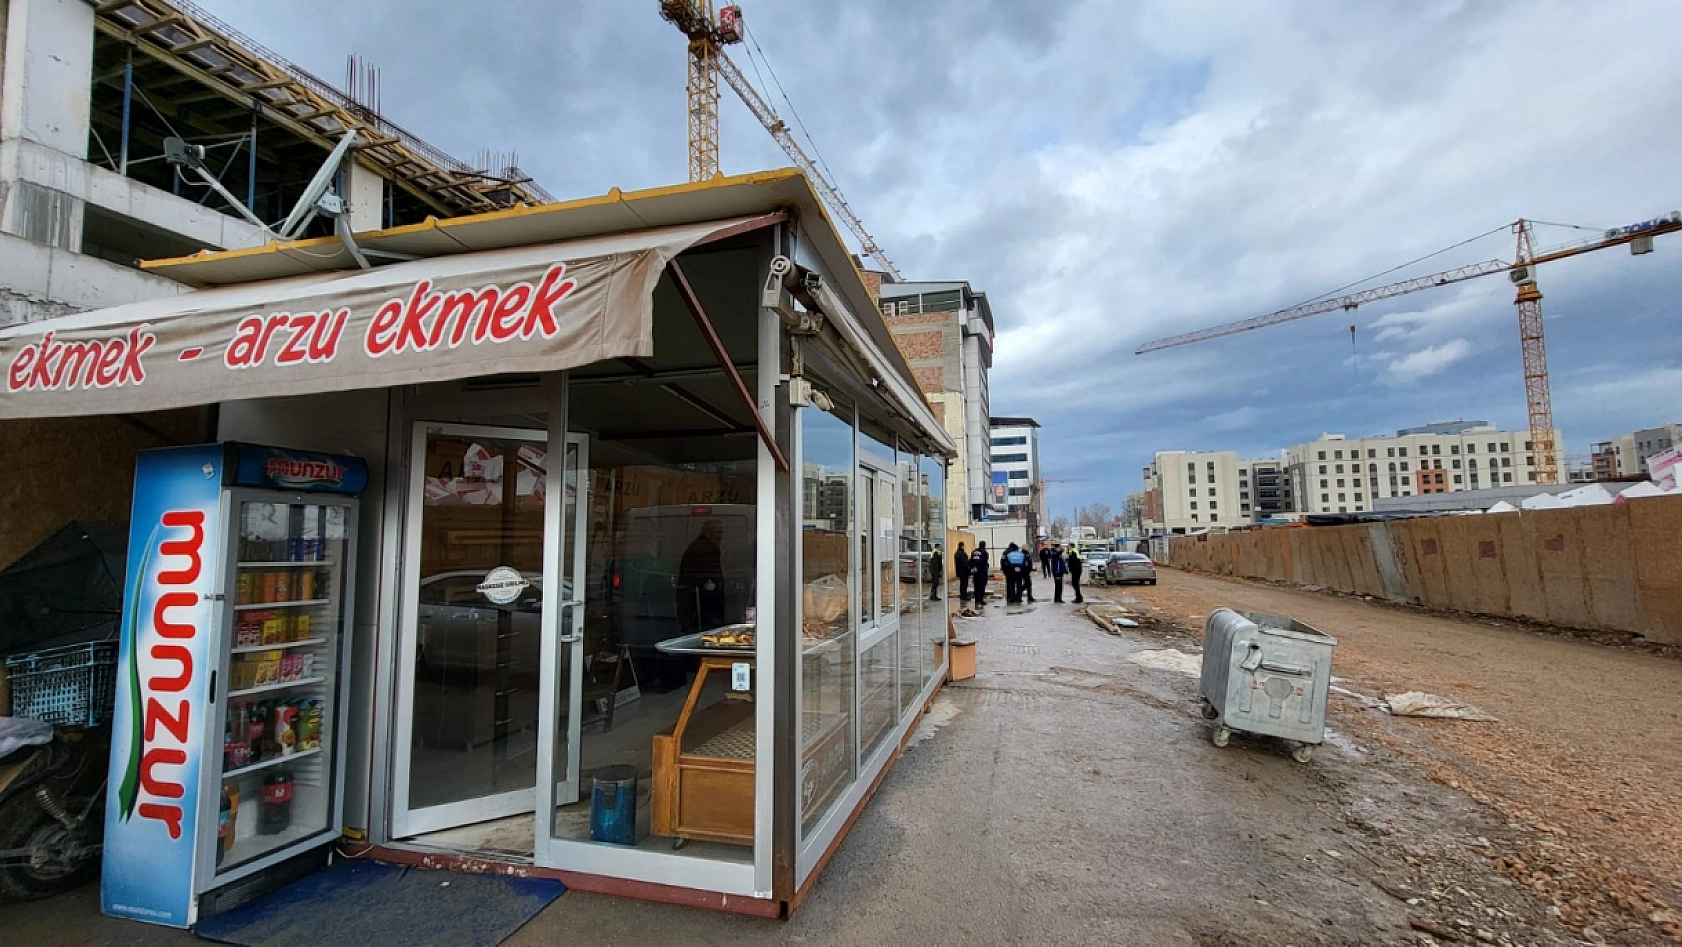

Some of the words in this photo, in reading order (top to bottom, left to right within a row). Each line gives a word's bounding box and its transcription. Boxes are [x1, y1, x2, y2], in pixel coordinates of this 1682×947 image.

[9, 331, 154, 391] ekmek
[225, 311, 350, 368] arzu
[366, 264, 577, 357] ekmek
[267, 457, 345, 480] munzur
[138, 510, 207, 841] munzur
